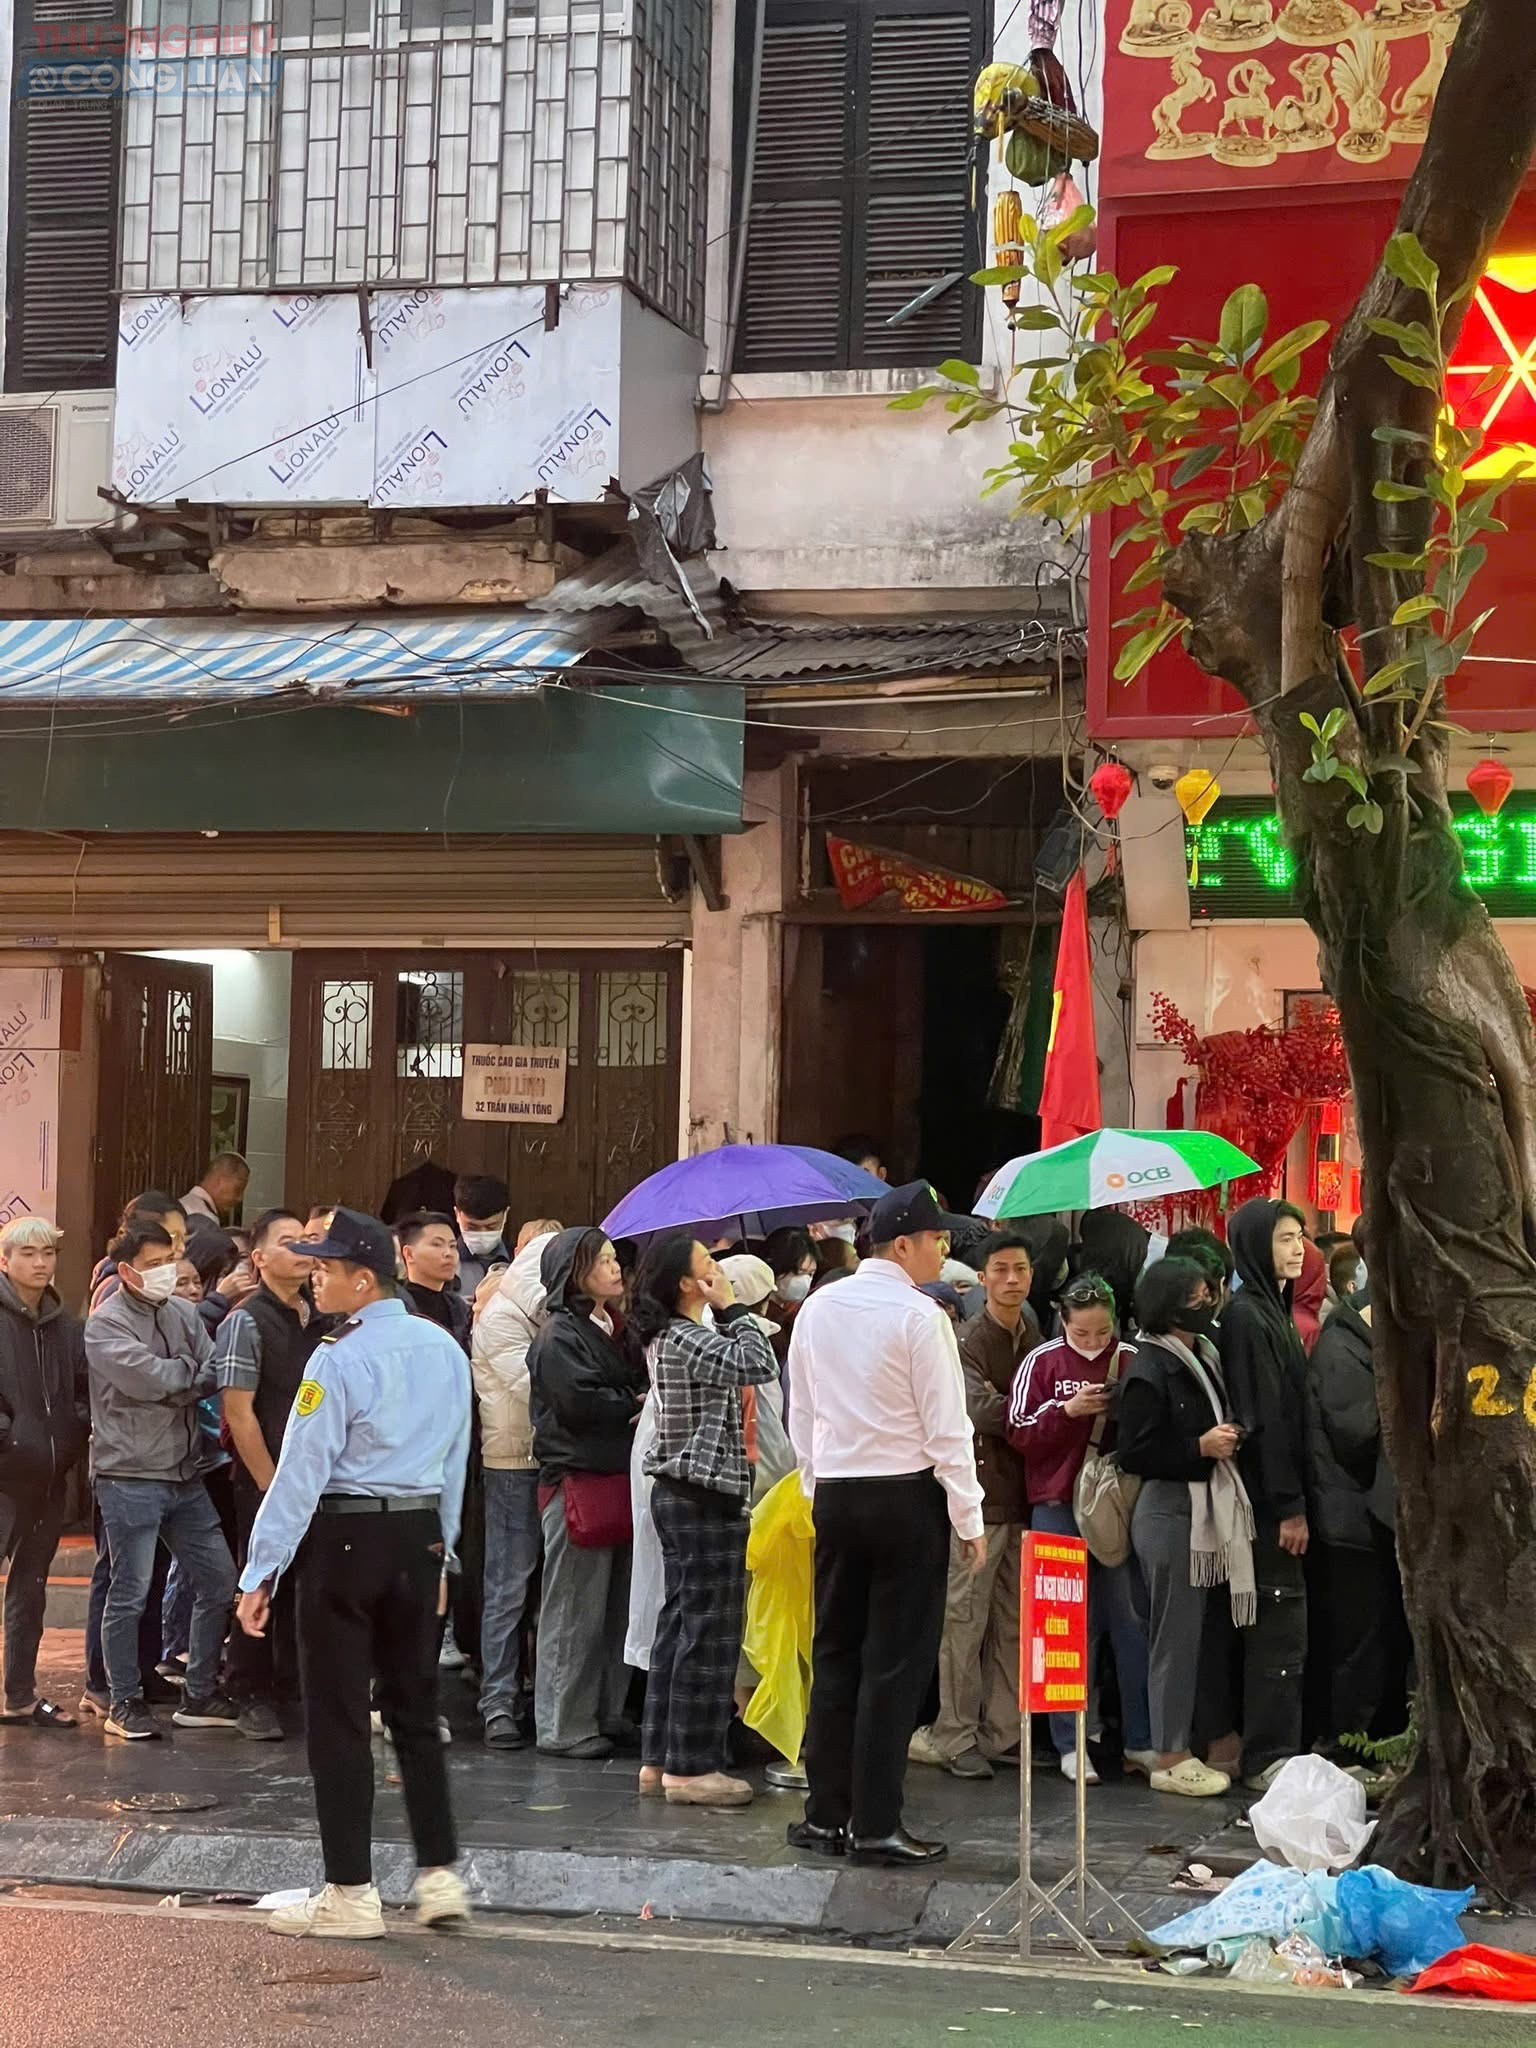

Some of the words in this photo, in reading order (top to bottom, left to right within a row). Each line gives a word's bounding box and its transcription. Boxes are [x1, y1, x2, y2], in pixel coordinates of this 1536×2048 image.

[189, 343, 262, 414] LIONALU
[457, 340, 531, 413] LIONALU
[268, 414, 340, 484] LIONALU
[375, 431, 448, 502] LIONALU
[537, 408, 611, 481] LIONALU
[471, 1051, 496, 1067] THUỐC
[498, 1056, 513, 1067] CAO
[515, 1057, 528, 1068] GIA
[475, 1101, 485, 1113] 32
[508, 1101, 530, 1115] NHÂN
[532, 1101, 552, 1115] TÔNG
[1127, 1167, 1171, 1184] OCB
